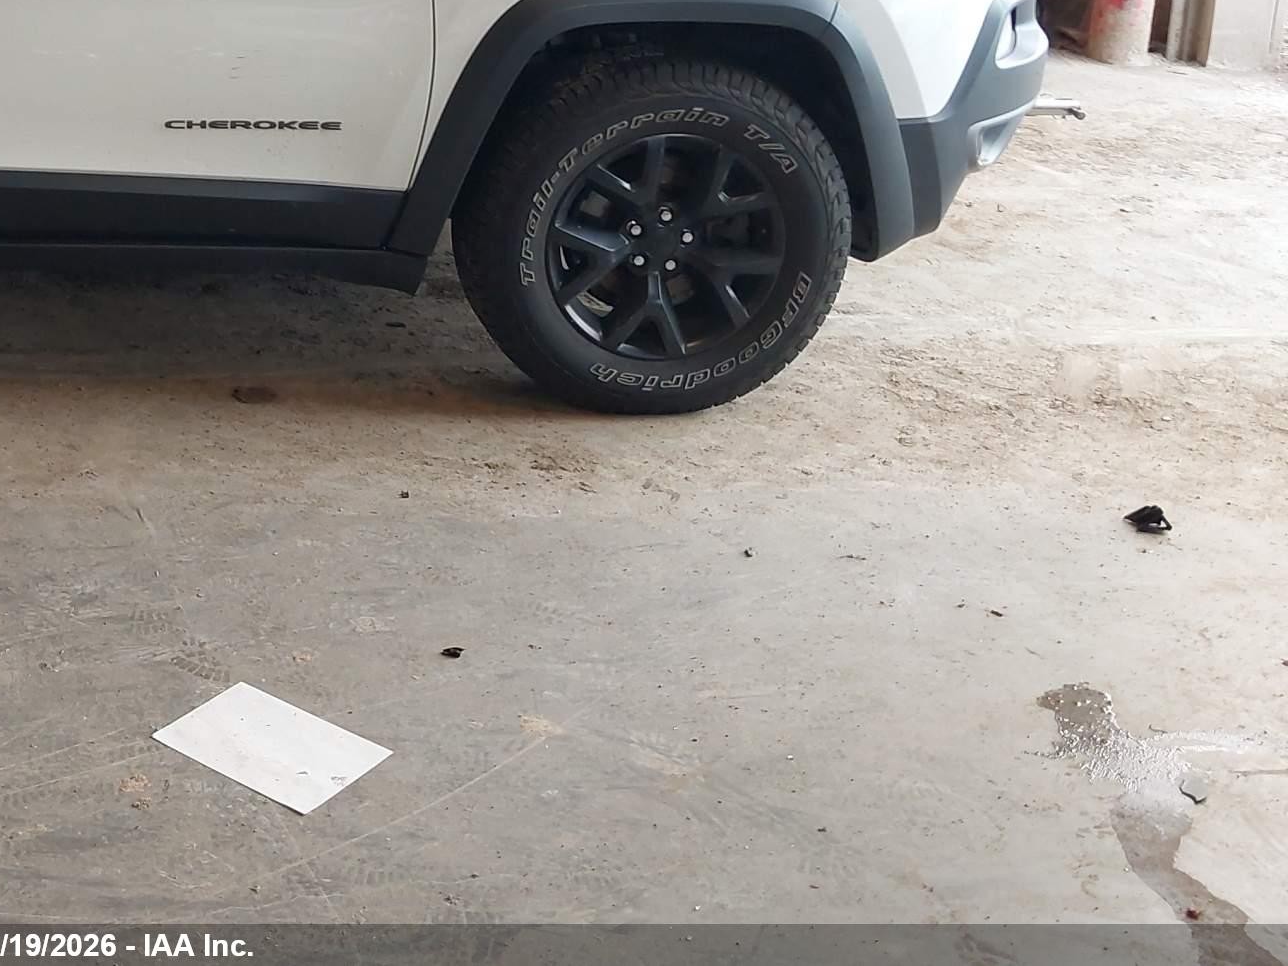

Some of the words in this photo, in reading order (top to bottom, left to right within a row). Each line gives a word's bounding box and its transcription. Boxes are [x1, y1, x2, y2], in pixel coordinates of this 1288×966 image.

[164, 120, 342, 130] CHEROKEE
[521, 107, 729, 286] Trail-Terrain
[744, 124, 798, 174] T/A
[589, 269, 813, 392] BFGoodrich
